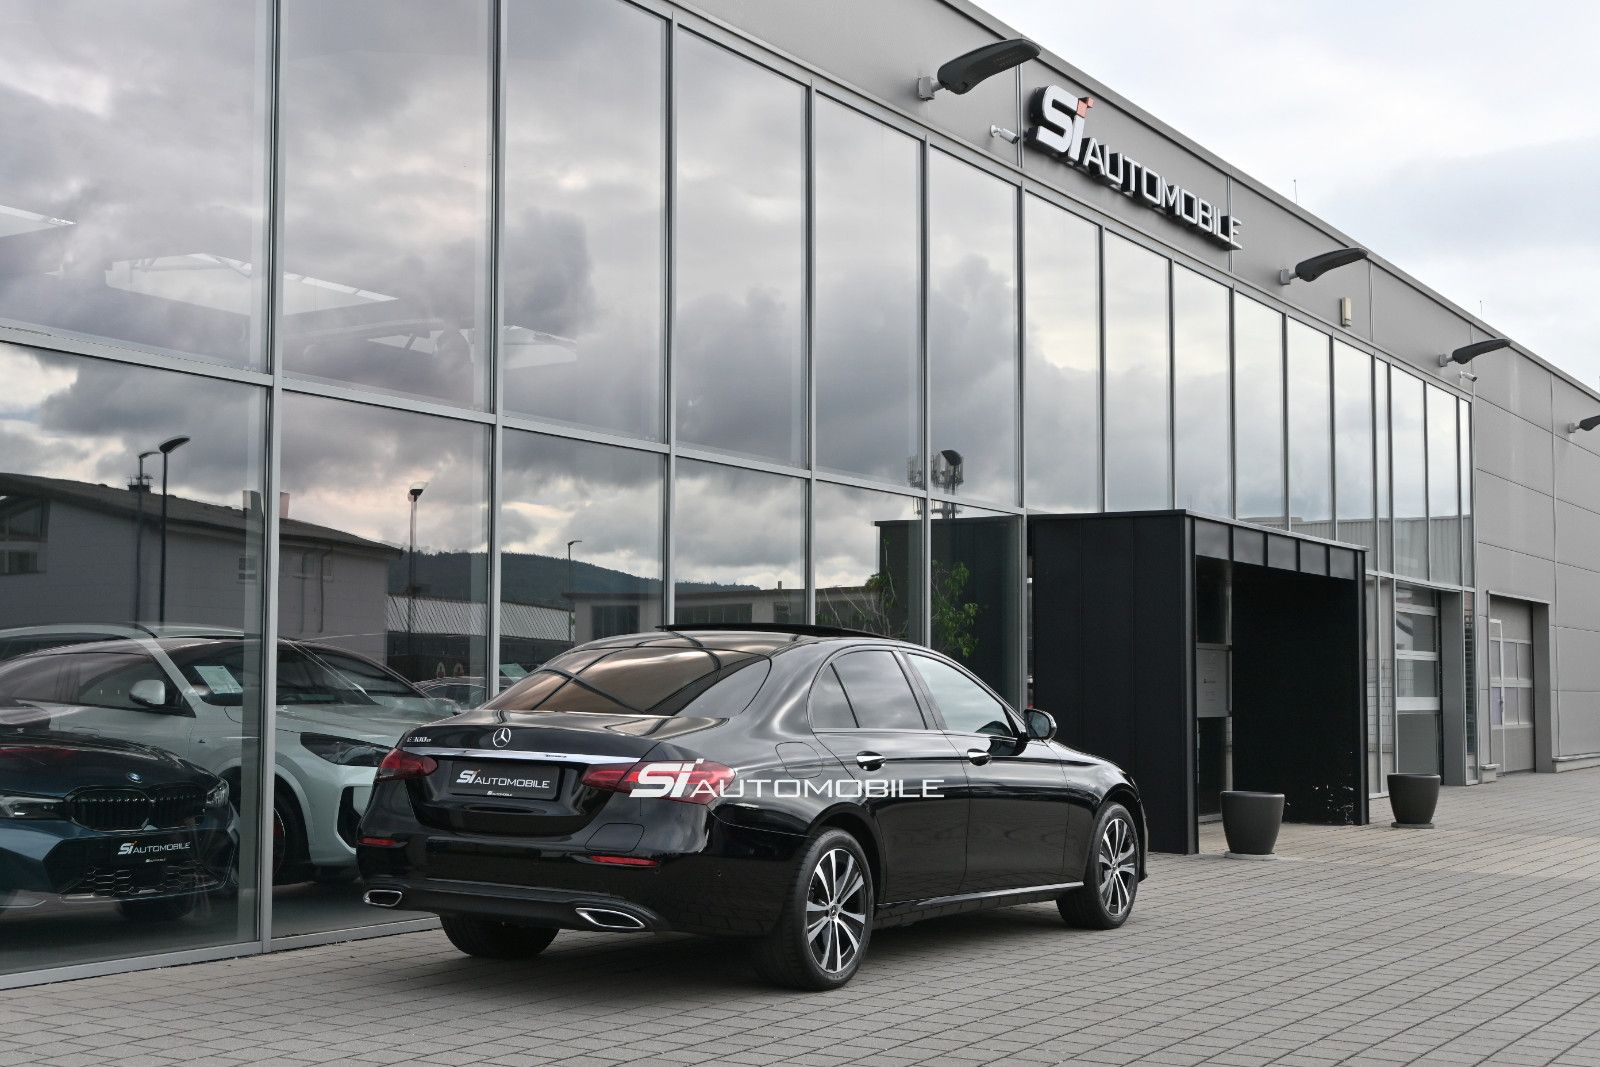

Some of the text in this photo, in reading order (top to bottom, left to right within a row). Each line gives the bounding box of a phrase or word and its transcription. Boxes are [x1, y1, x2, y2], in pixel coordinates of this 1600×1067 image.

[1083, 137, 1243, 250] AUTOMOBILE
[473, 776, 550, 789] AUTOMOBILE
[133, 842, 191, 853] AUTOMOBILE
